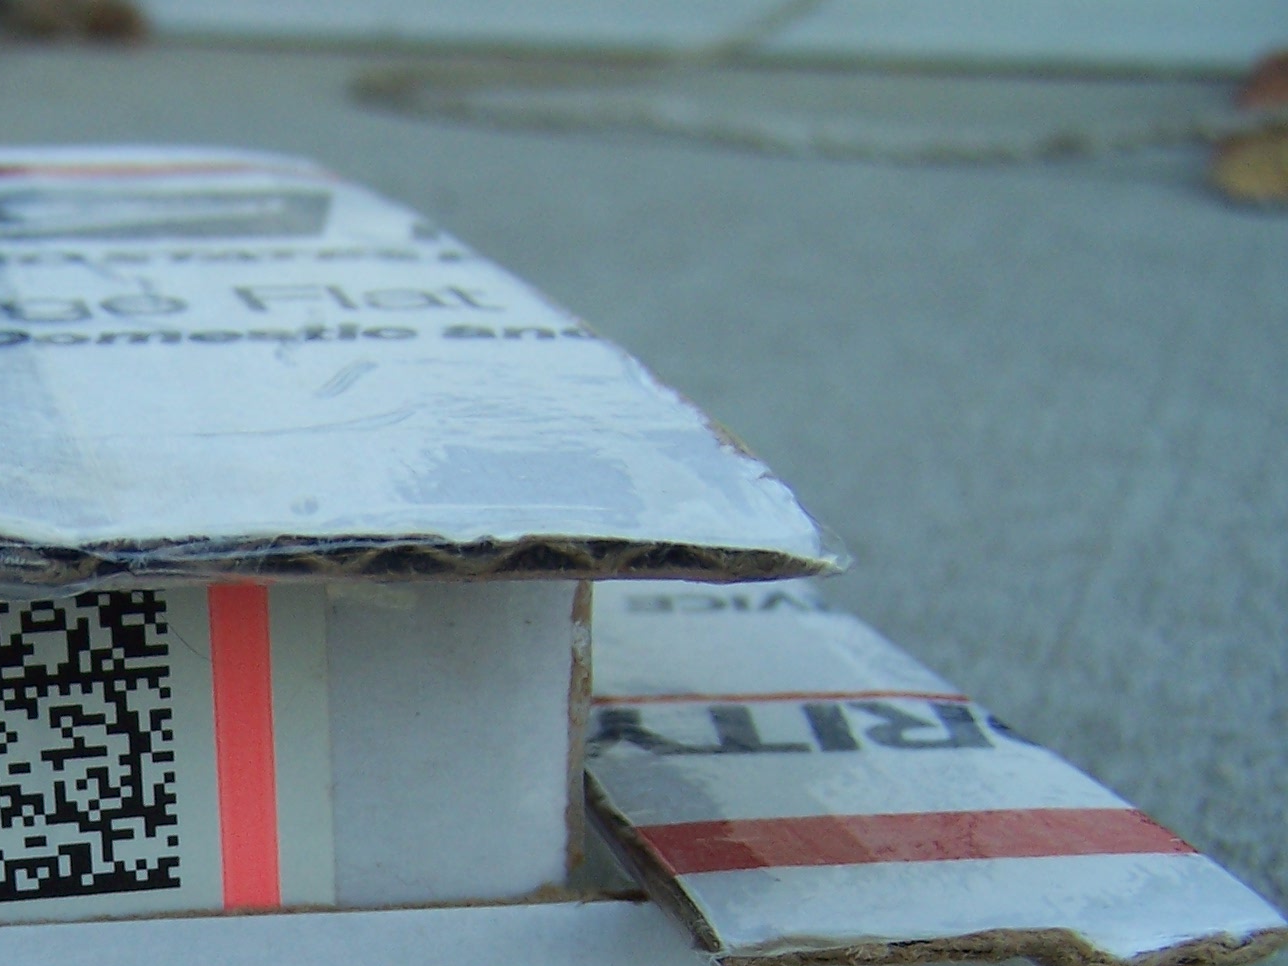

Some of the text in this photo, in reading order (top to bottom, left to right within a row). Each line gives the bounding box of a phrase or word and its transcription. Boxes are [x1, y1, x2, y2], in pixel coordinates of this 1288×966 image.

[231, 284, 508, 313] Flat
[626, 591, 826, 614] VICE
[584, 701, 1032, 754] RITY
